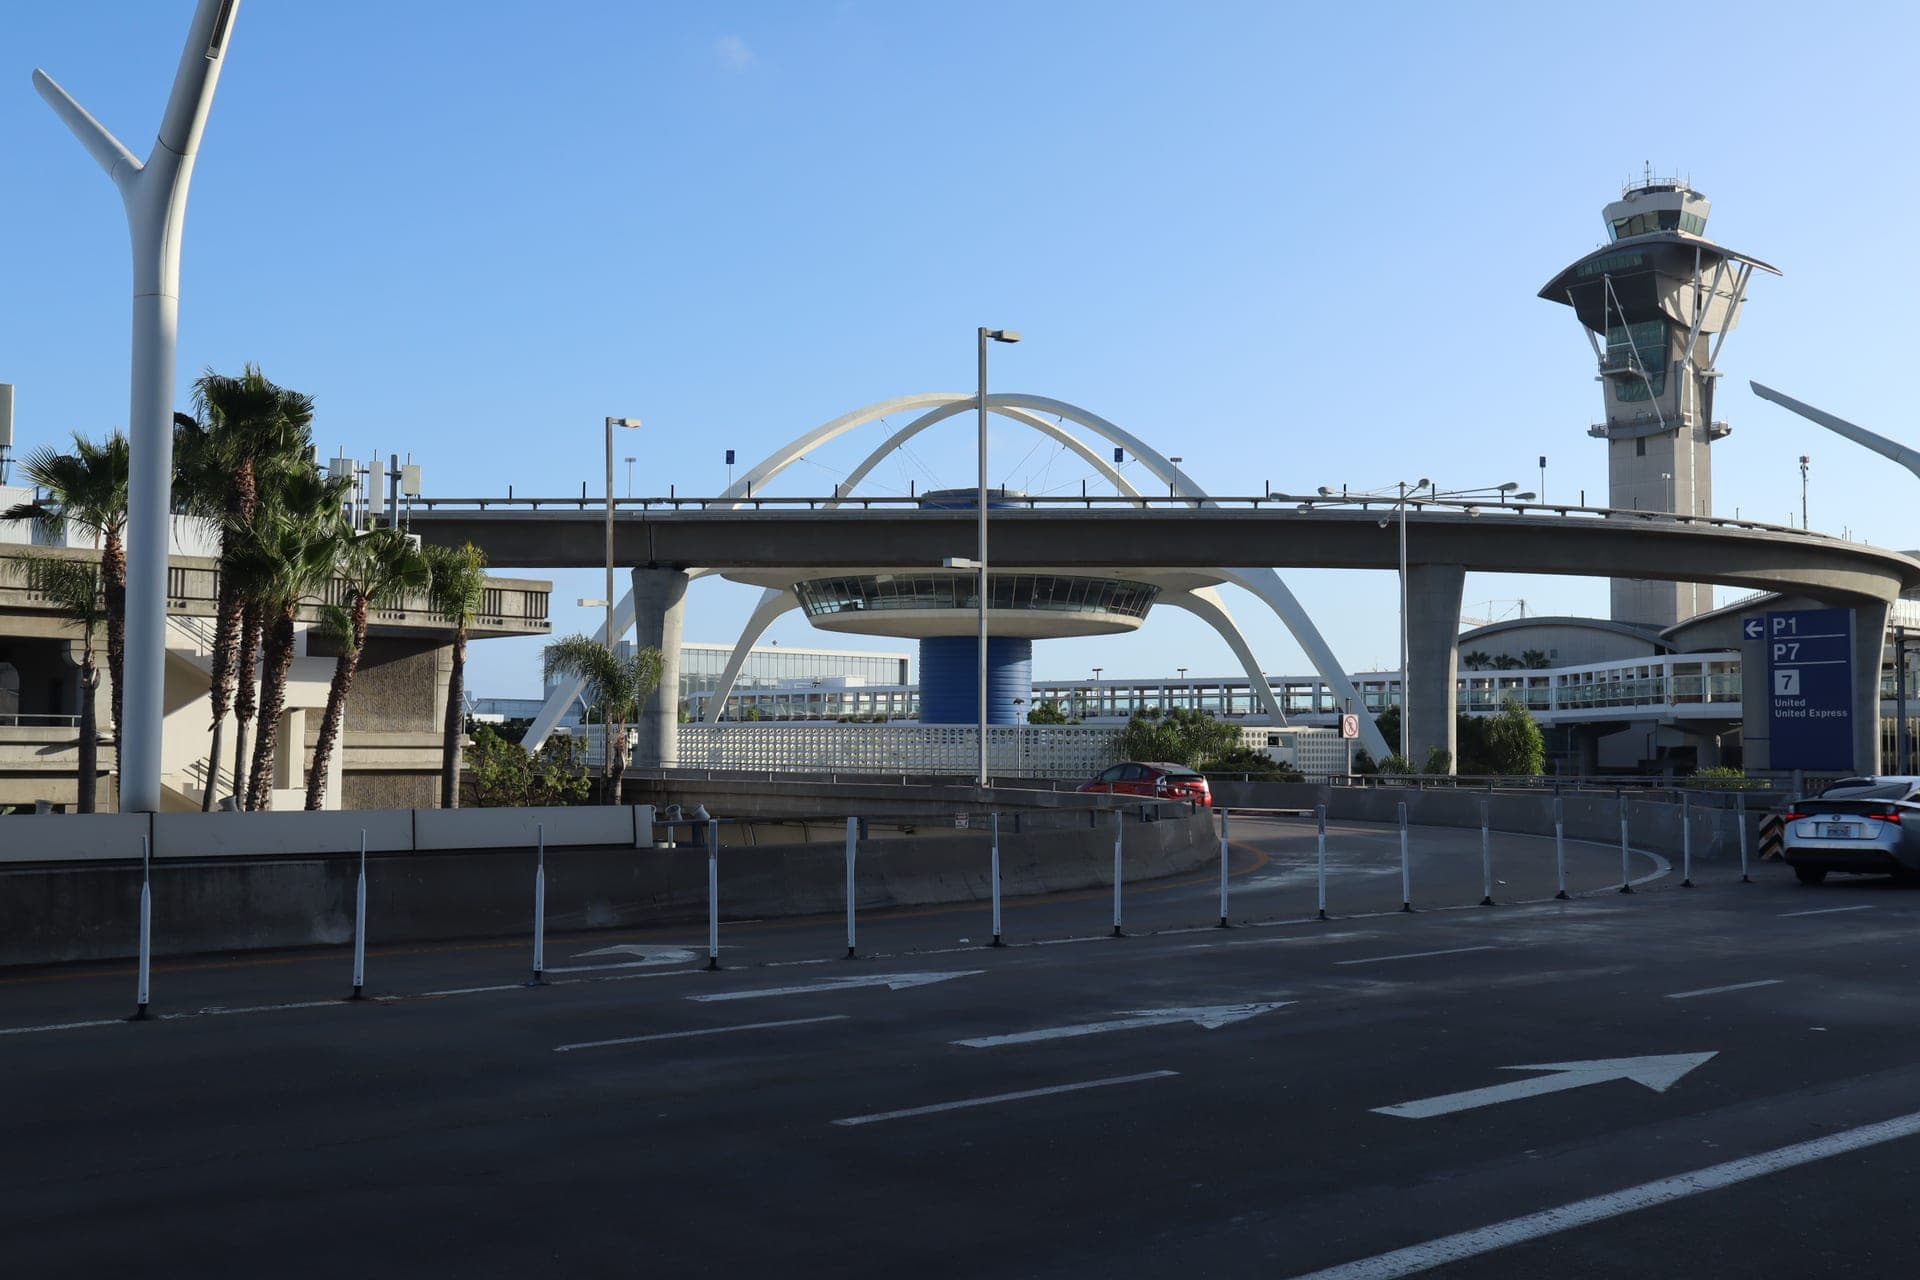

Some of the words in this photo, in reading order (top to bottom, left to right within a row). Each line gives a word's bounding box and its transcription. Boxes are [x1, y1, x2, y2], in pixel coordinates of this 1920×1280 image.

[1773, 617, 1797, 635] P1
[1773, 643, 1800, 661] P7
[1781, 675, 1792, 690] 7
[1775, 699, 1806, 707] United
[1775, 709, 1806, 717] United
[1809, 709, 1848, 719] Express
